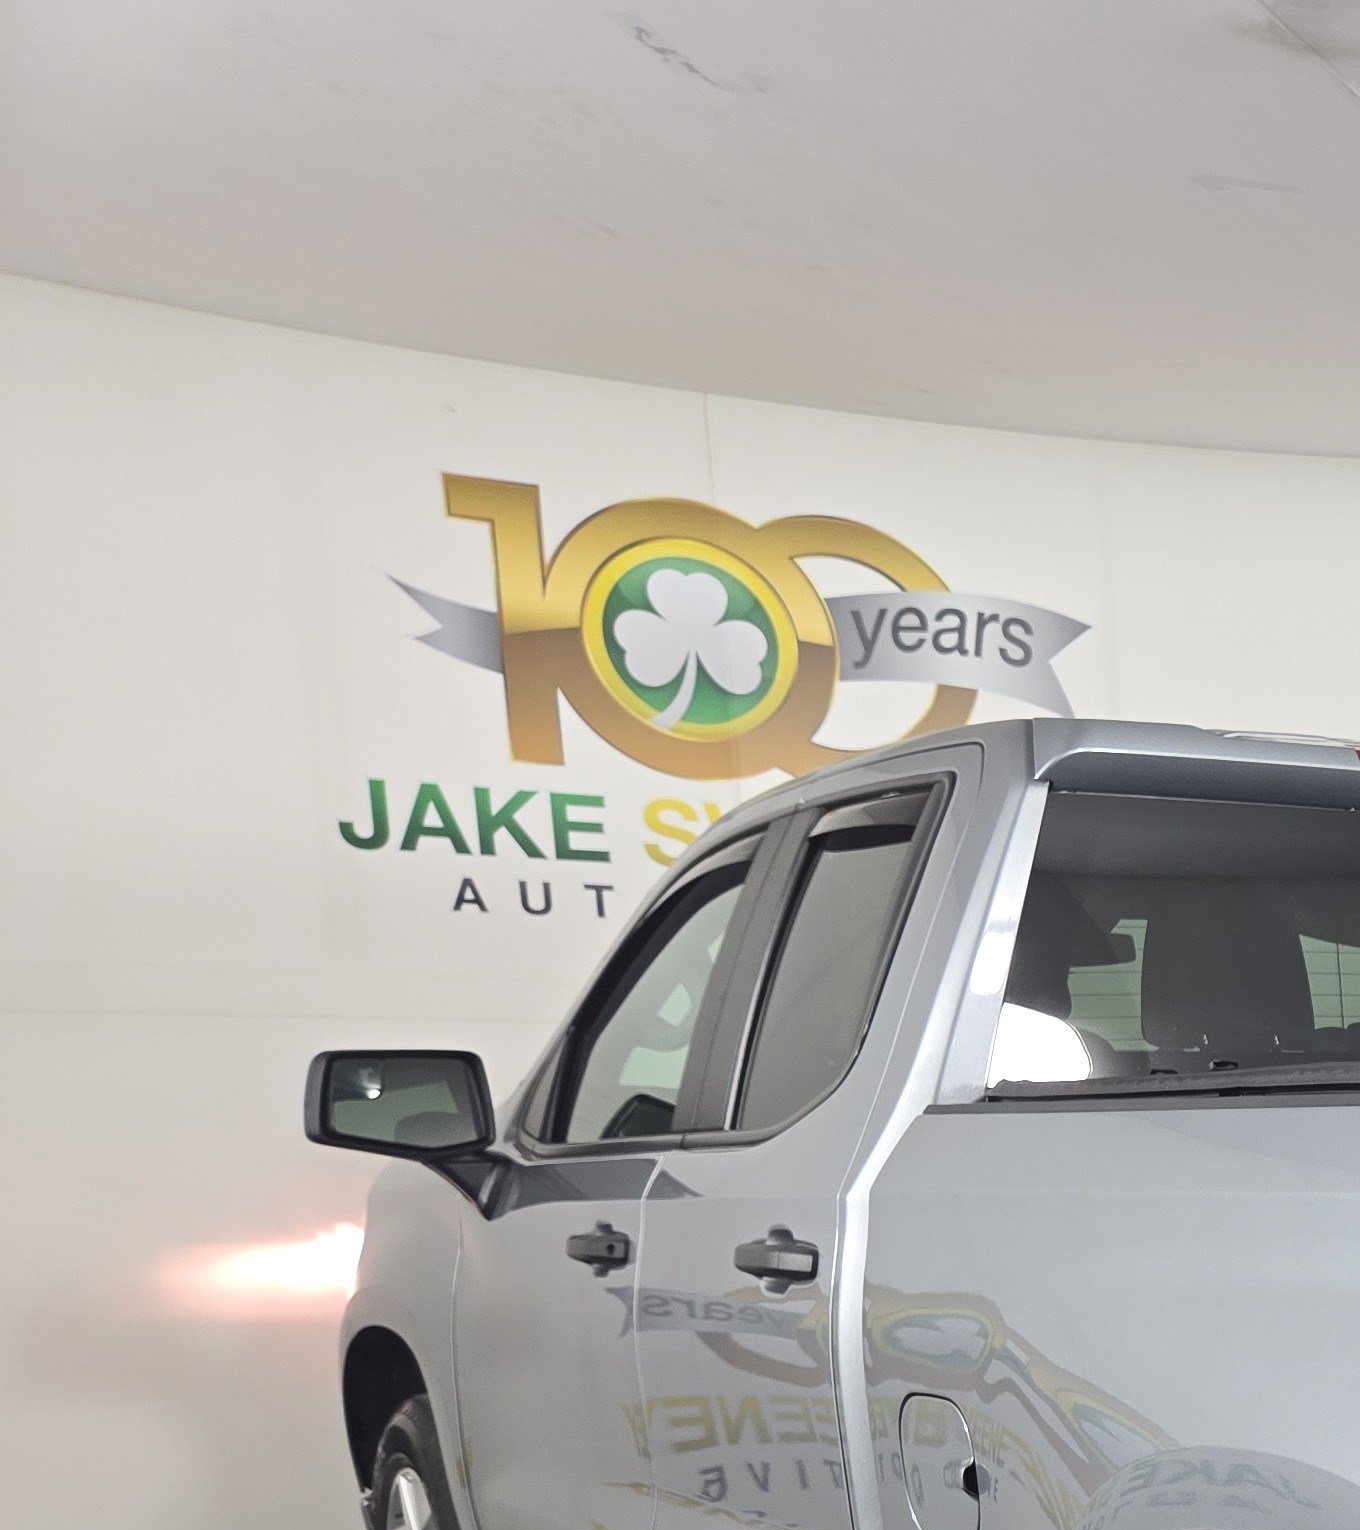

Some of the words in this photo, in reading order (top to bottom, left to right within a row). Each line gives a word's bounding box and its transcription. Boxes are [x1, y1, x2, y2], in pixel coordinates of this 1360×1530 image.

[440, 471, 979, 781] 100
[850, 600, 1035, 669] years
[338, 778, 611, 863] JAKE
